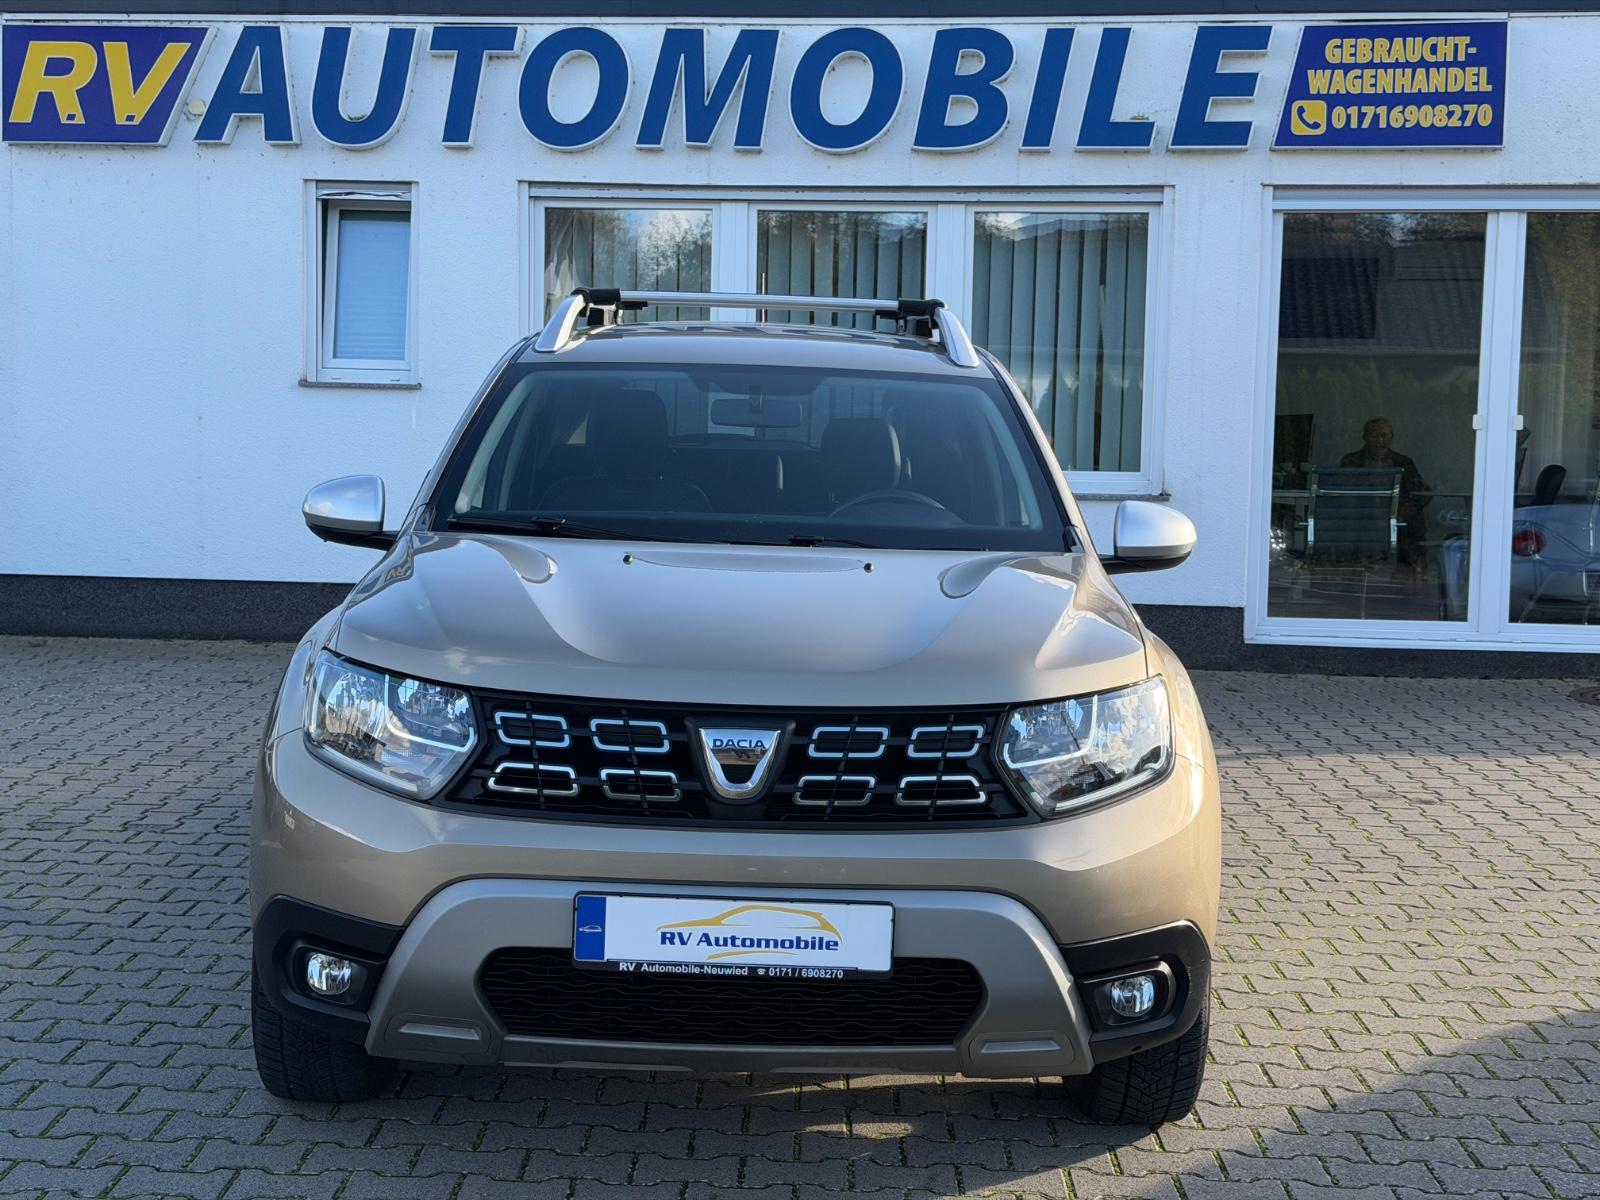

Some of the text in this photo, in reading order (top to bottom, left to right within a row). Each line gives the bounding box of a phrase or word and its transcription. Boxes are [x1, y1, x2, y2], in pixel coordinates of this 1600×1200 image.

[1325, 36, 1477, 64] GEBRAUCHT-
[9, 25, 1272, 152] RV AUTOMOBILE
[1307, 66, 1493, 94] WAGENHANDEL
[1331, 104, 1493, 129] 01716908270
[713, 738, 766, 748] DACIA
[660, 931, 839, 951] RV Automobile
[619, 961, 635, 972] RV
[641, 962, 748, 976] Automobile-Neuwied
[768, 966, 793, 978] 0171
[801, 967, 844, 979] 6908270
